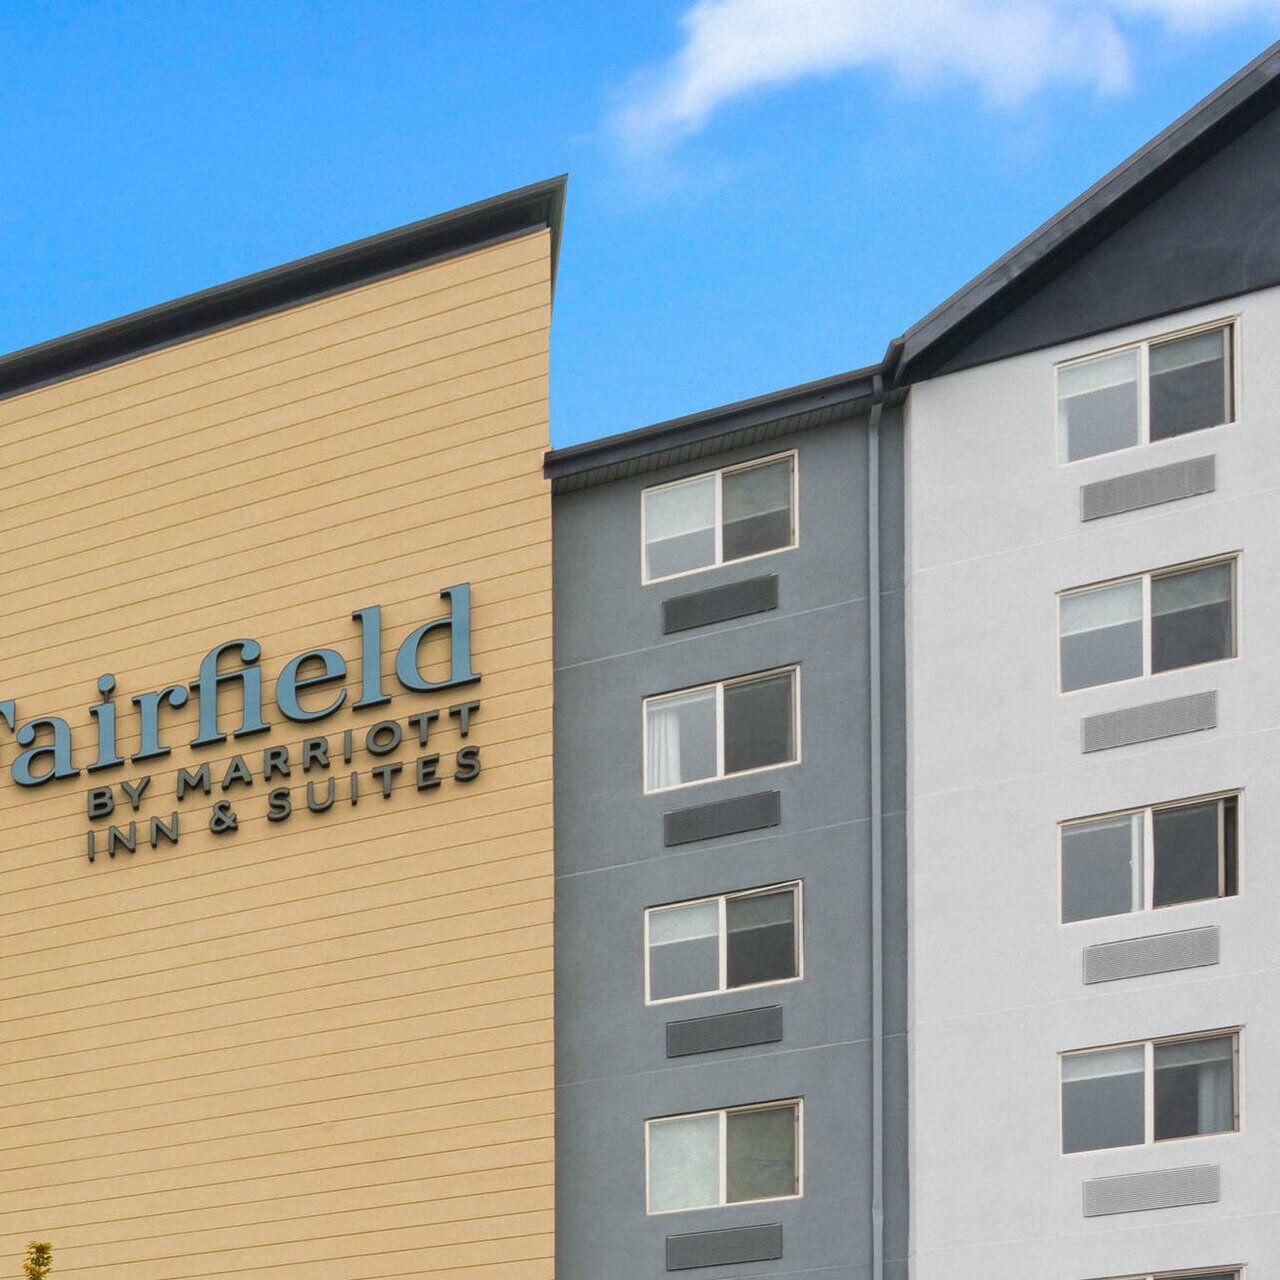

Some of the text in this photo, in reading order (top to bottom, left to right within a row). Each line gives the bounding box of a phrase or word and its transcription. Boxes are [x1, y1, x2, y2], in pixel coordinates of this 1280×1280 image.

[87, 700, 481, 821] BY MARRIOTT
[87, 745, 481, 862] INN & SUITES
